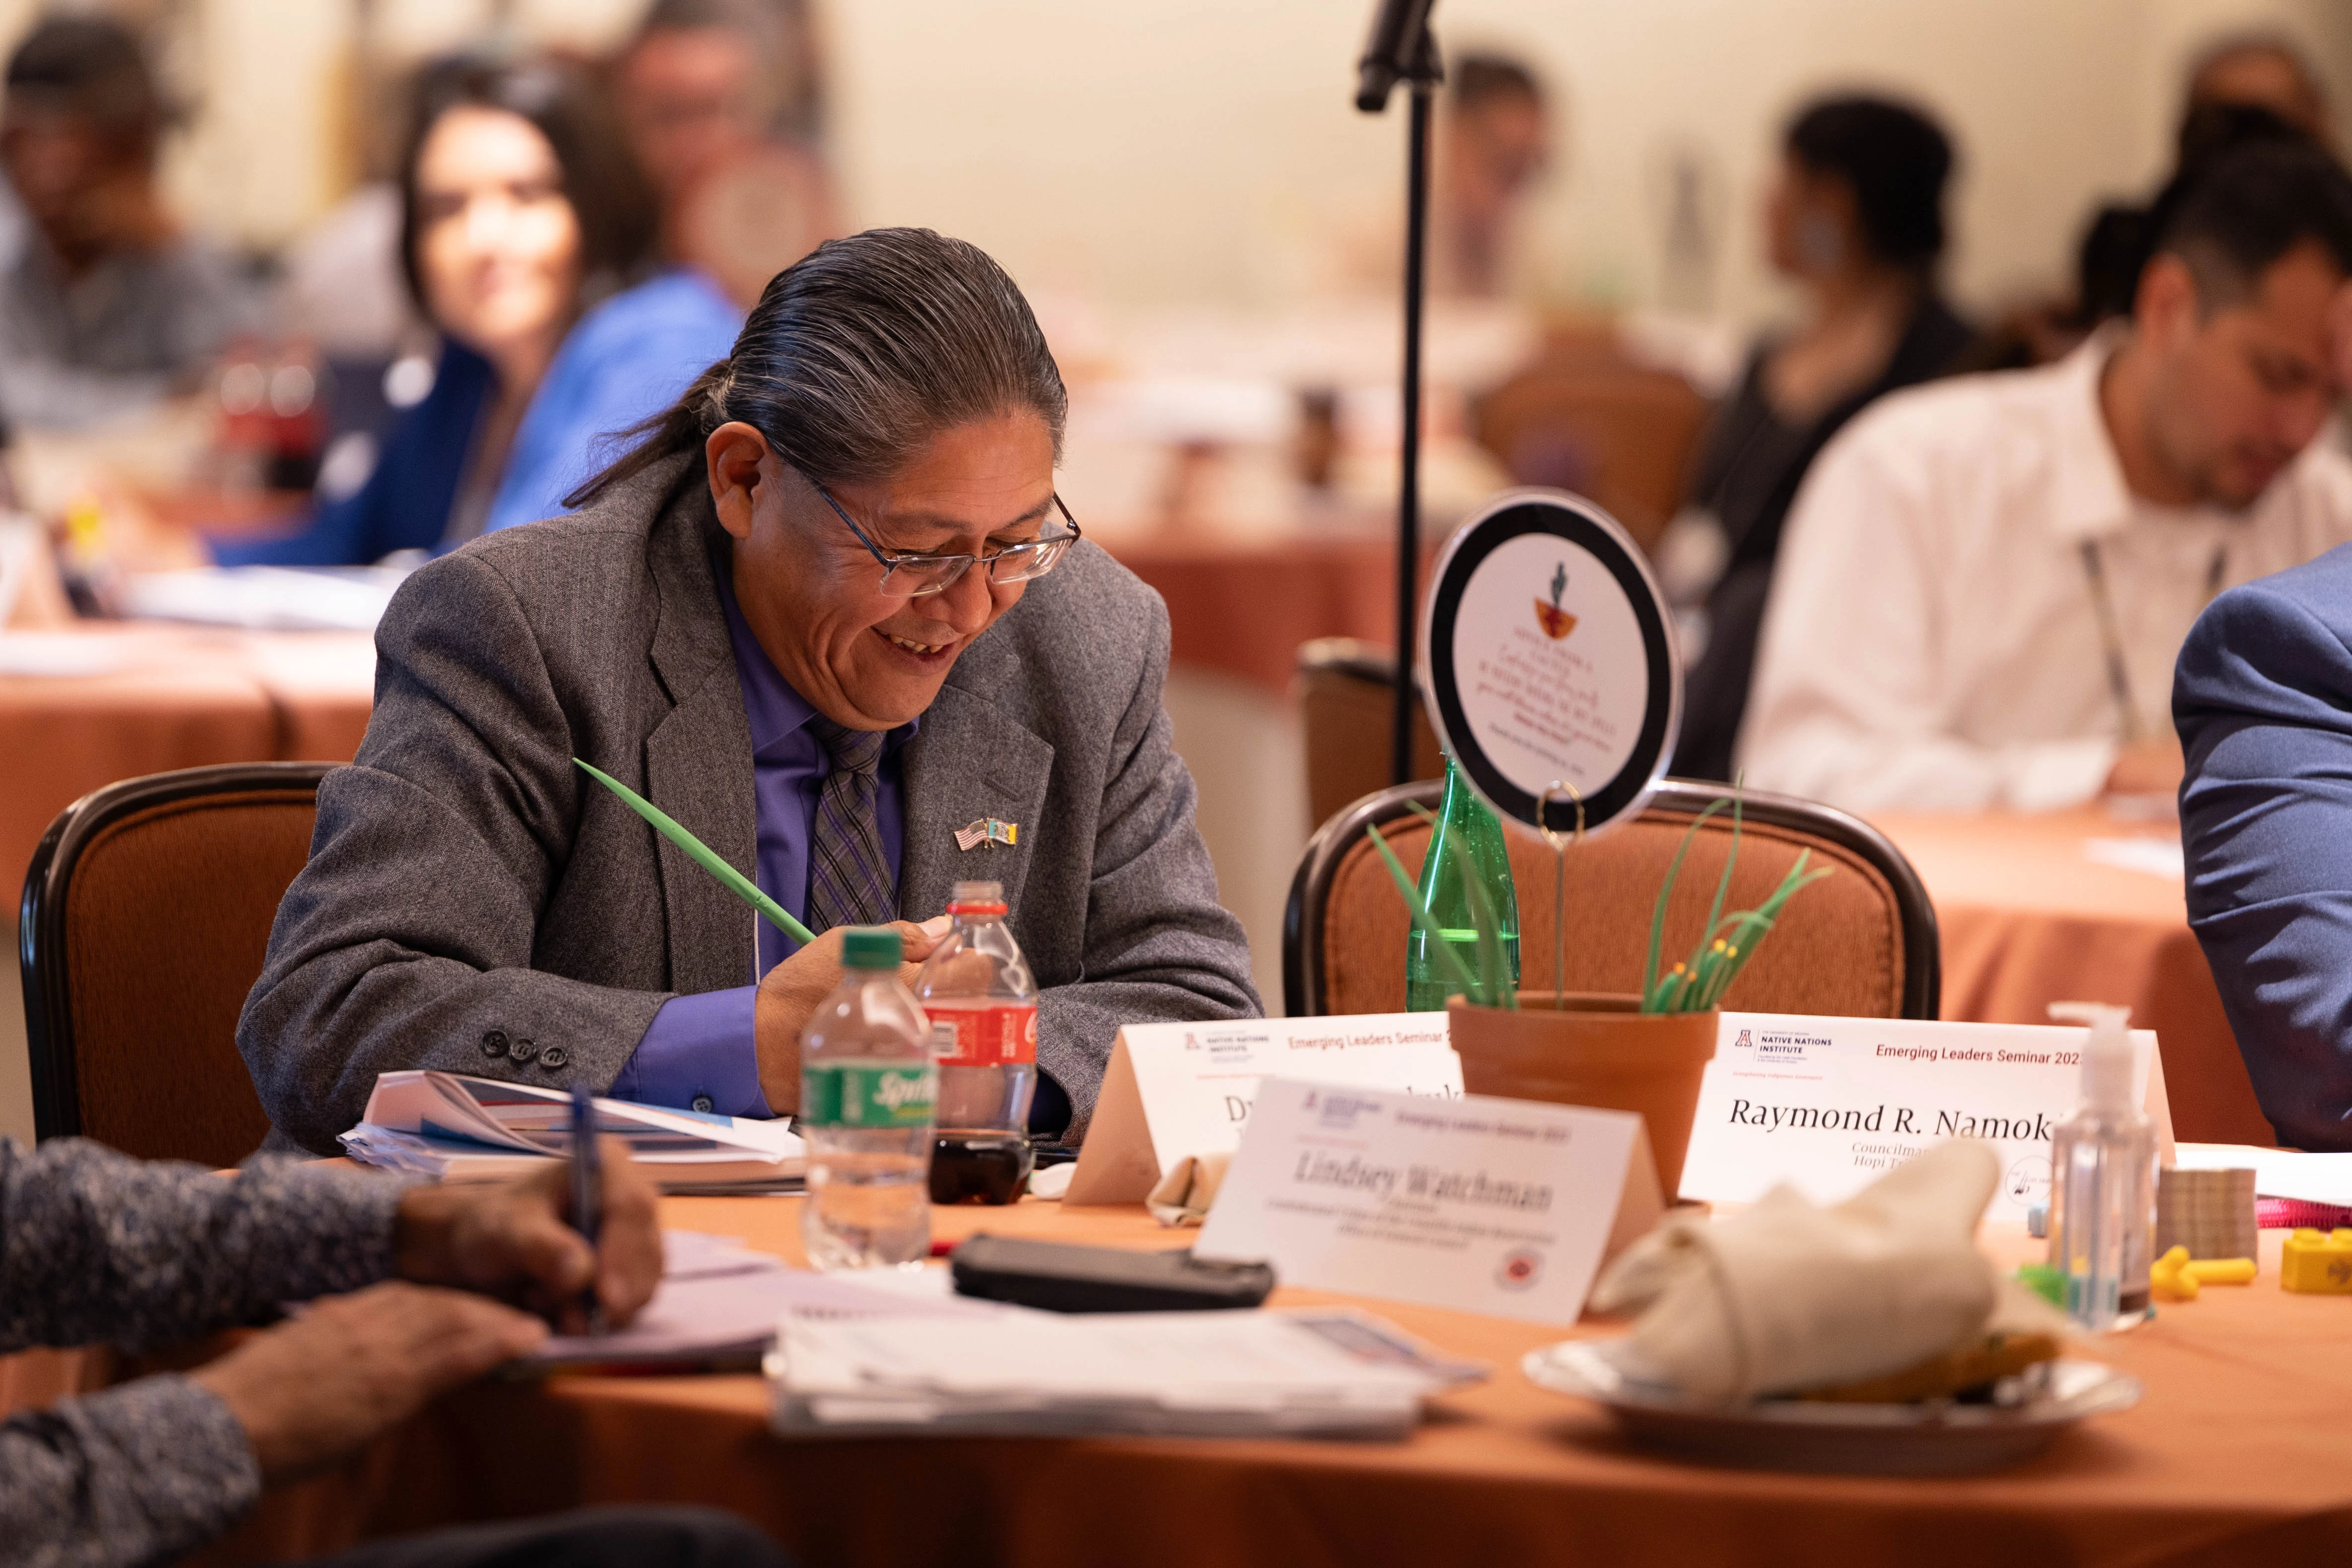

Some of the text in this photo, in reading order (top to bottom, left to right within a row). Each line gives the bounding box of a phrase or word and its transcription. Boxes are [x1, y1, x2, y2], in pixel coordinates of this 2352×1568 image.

[1288, 1035, 1344, 1051] Emerging
[1346, 1033, 1392, 1047] Leaders
[1395, 1030, 1442, 1044] Seminar
[1759, 1045, 1803, 1054] INSTITUTE
[1761, 1036, 1792, 1045] NATIVE
[1876, 1044, 2082, 1065] Emerging Leaders Seminar 202
[1729, 1099, 2063, 1141] Raymond R. Namok
[1854, 1155, 1885, 1170] Hopi
